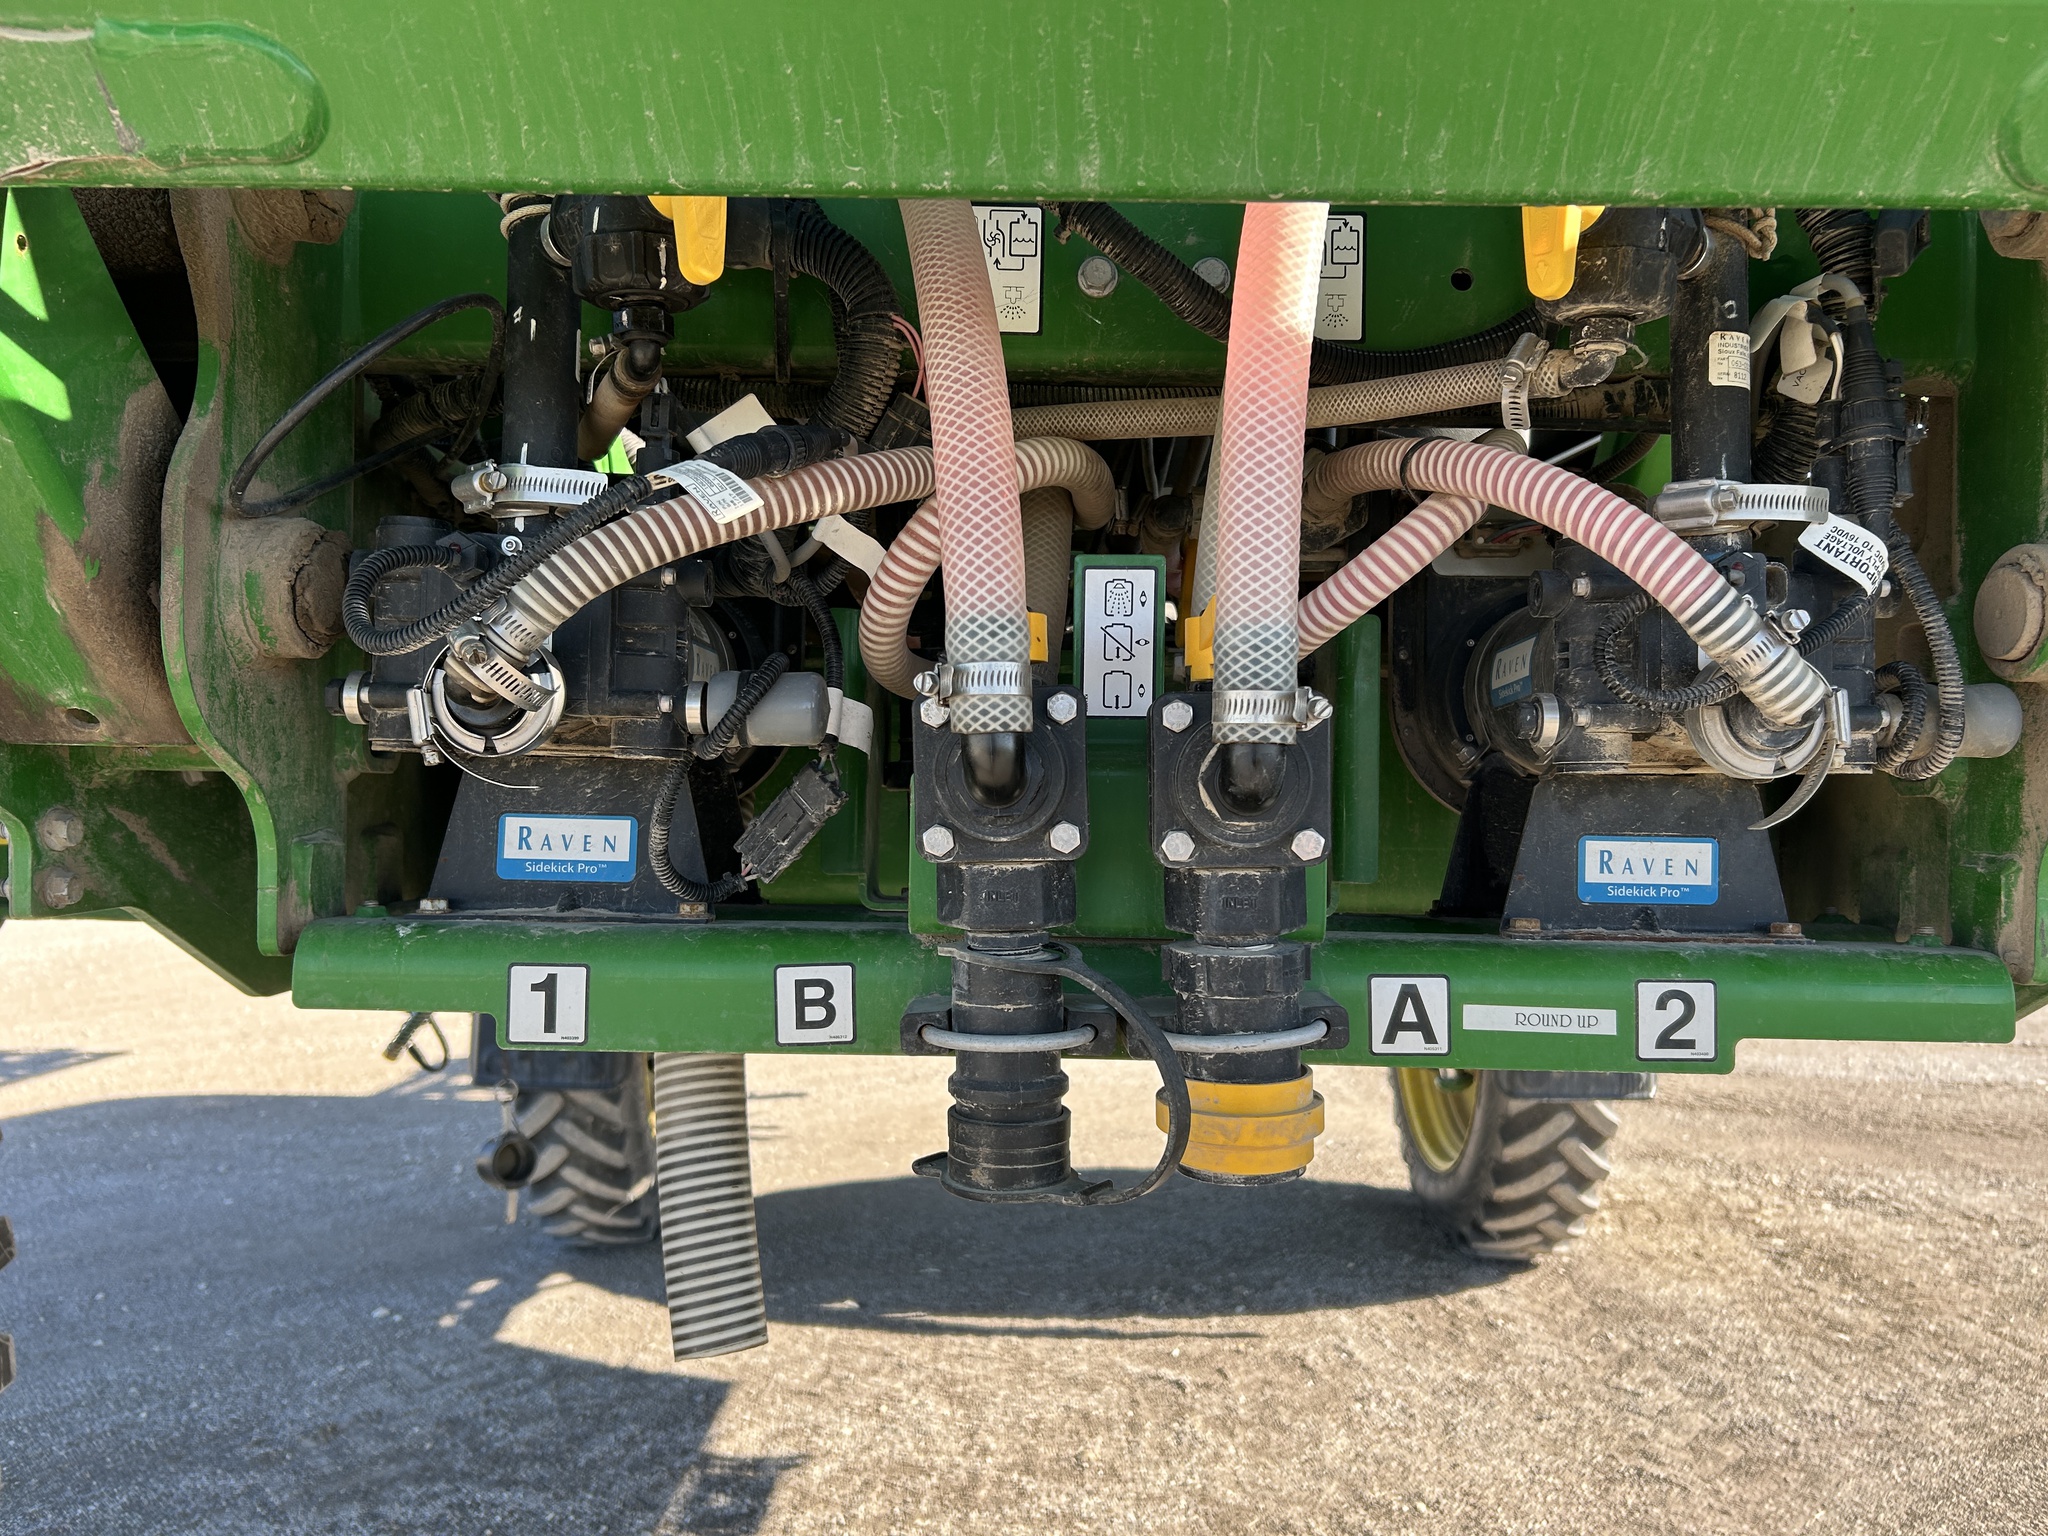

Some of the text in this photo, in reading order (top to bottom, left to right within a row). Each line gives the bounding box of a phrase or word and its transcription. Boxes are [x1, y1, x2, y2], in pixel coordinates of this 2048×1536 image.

[692, 486, 721, 517] RAVEN
[1823, 532, 1865, 557] VOLTAGE
[1829, 525, 1860, 543] 16VDC
[1861, 540, 1874, 552] TO
[1495, 653, 1528, 681] RAVEN
[517, 825, 617, 853] RAVEN
[525, 861, 574, 873] Sidekick
[1599, 849, 1698, 876] RAVEN
[1221, 896, 1258, 909] INLET
[1607, 885, 1657, 897] Sidekick
[530, 972, 558, 1034] 1
[794, 978, 837, 1030] B
[1381, 983, 1439, 1045] A
[1514, 1012, 1599, 1028] ROUND UP
[1654, 988, 1696, 1050] 2
